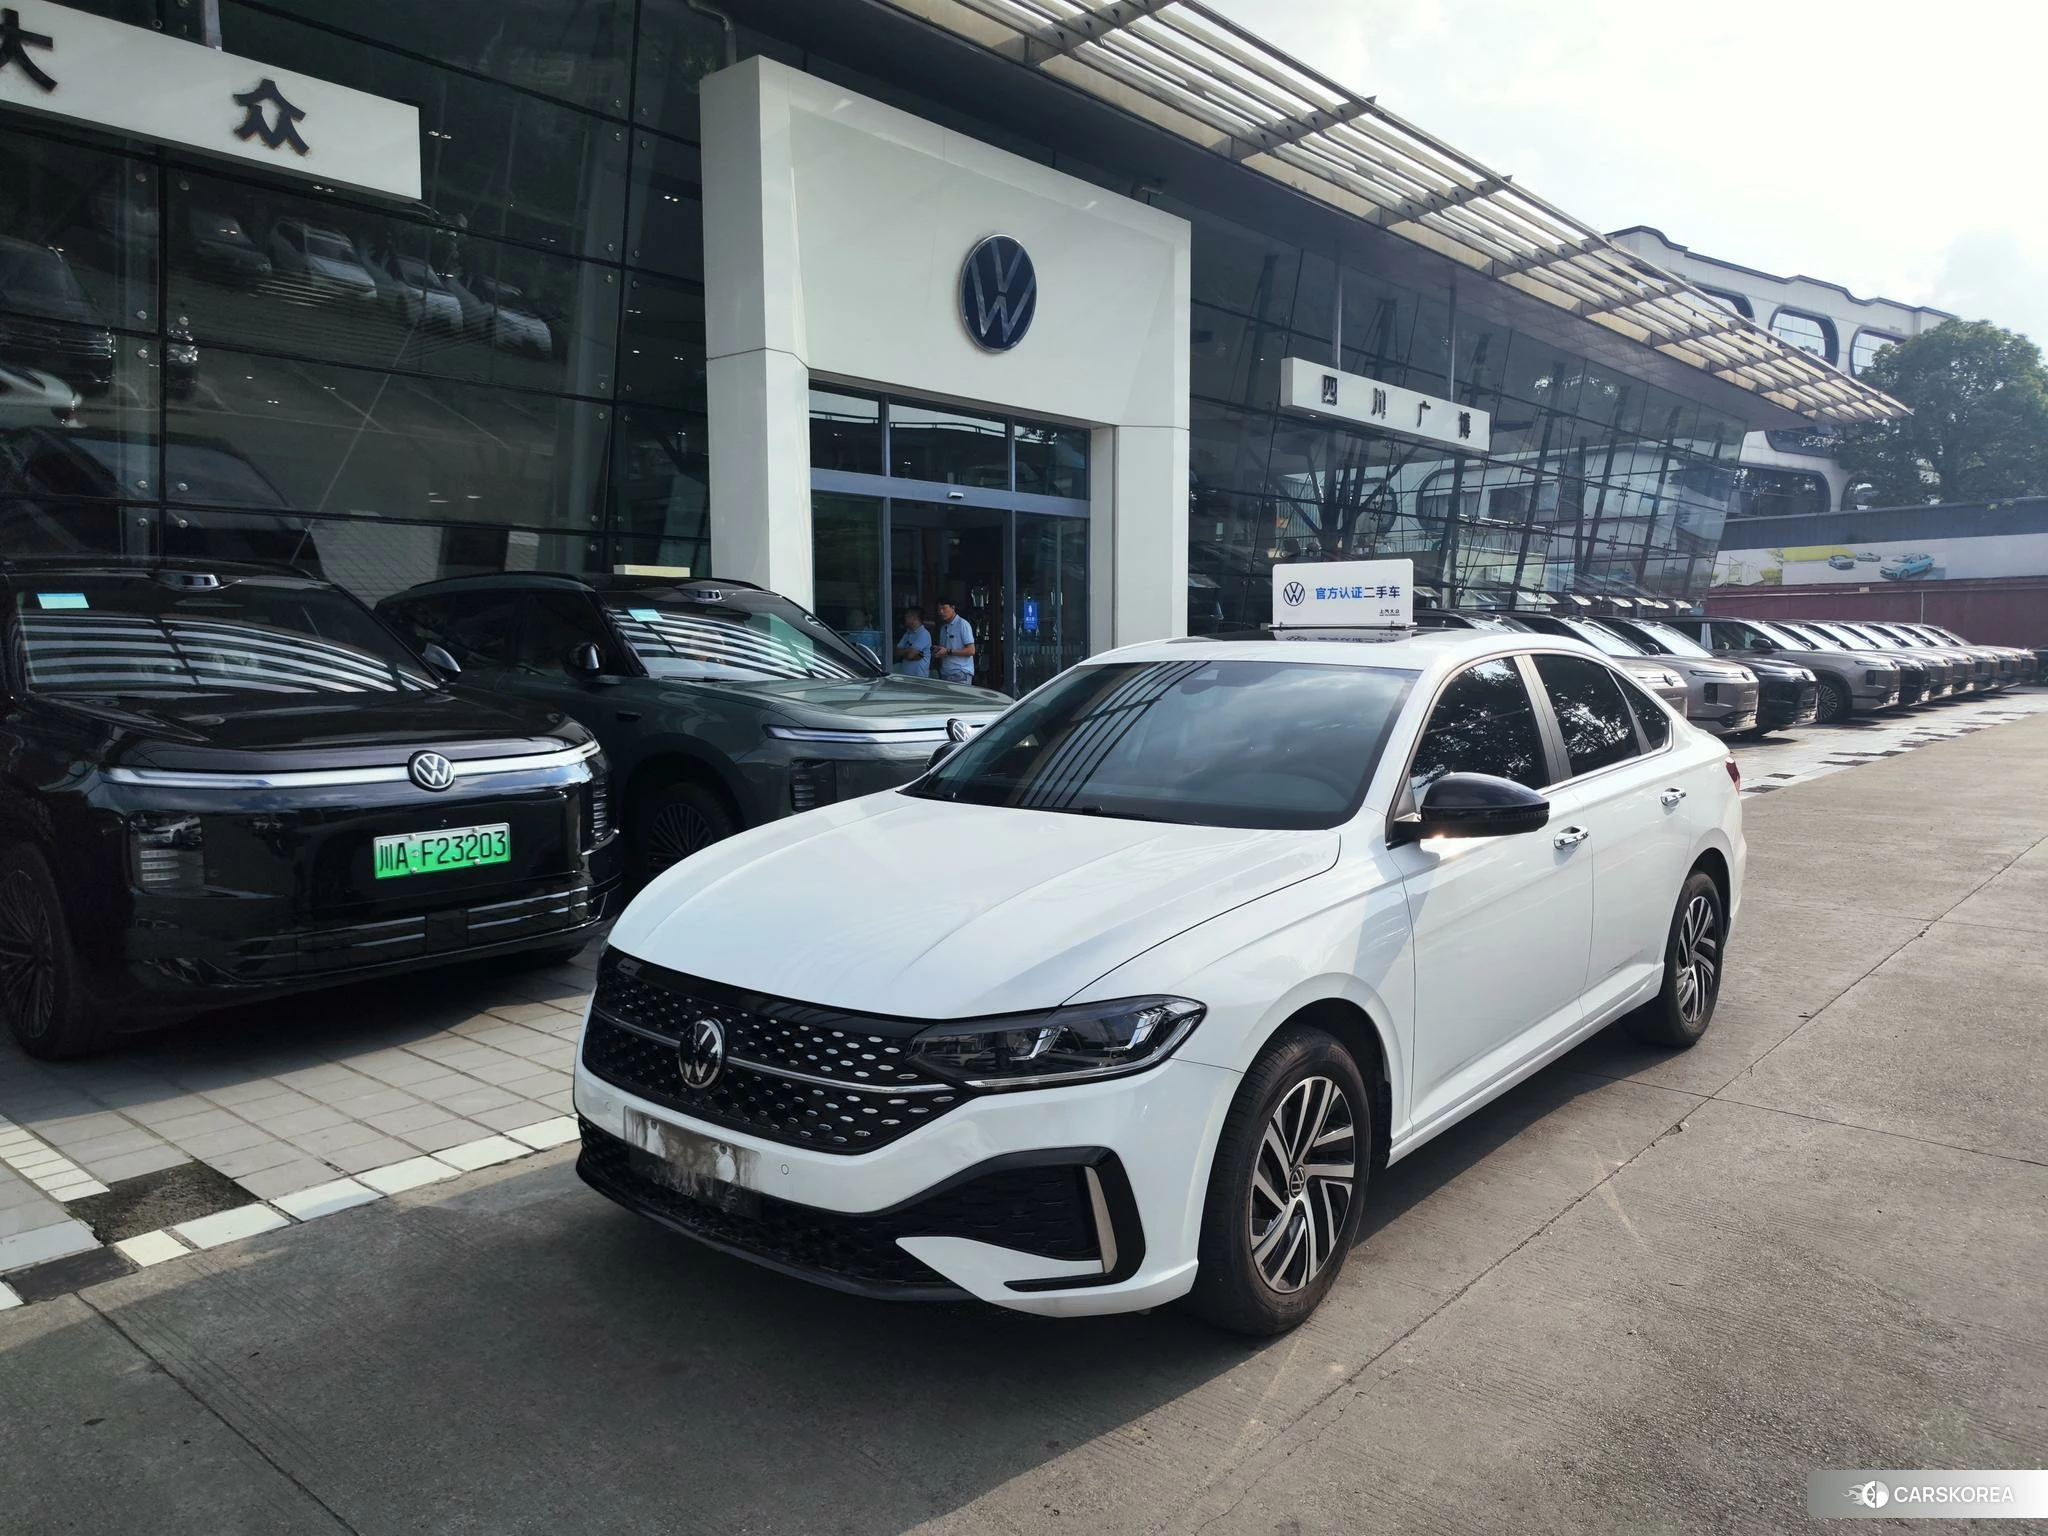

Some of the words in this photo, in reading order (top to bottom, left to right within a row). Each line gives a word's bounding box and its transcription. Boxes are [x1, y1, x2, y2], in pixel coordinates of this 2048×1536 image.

[962, 235, 1037, 352] VW
[1283, 581, 1305, 606] VW
[1315, 585, 1400, 600] 官方认证二手车
[414, 753, 455, 789] VW
